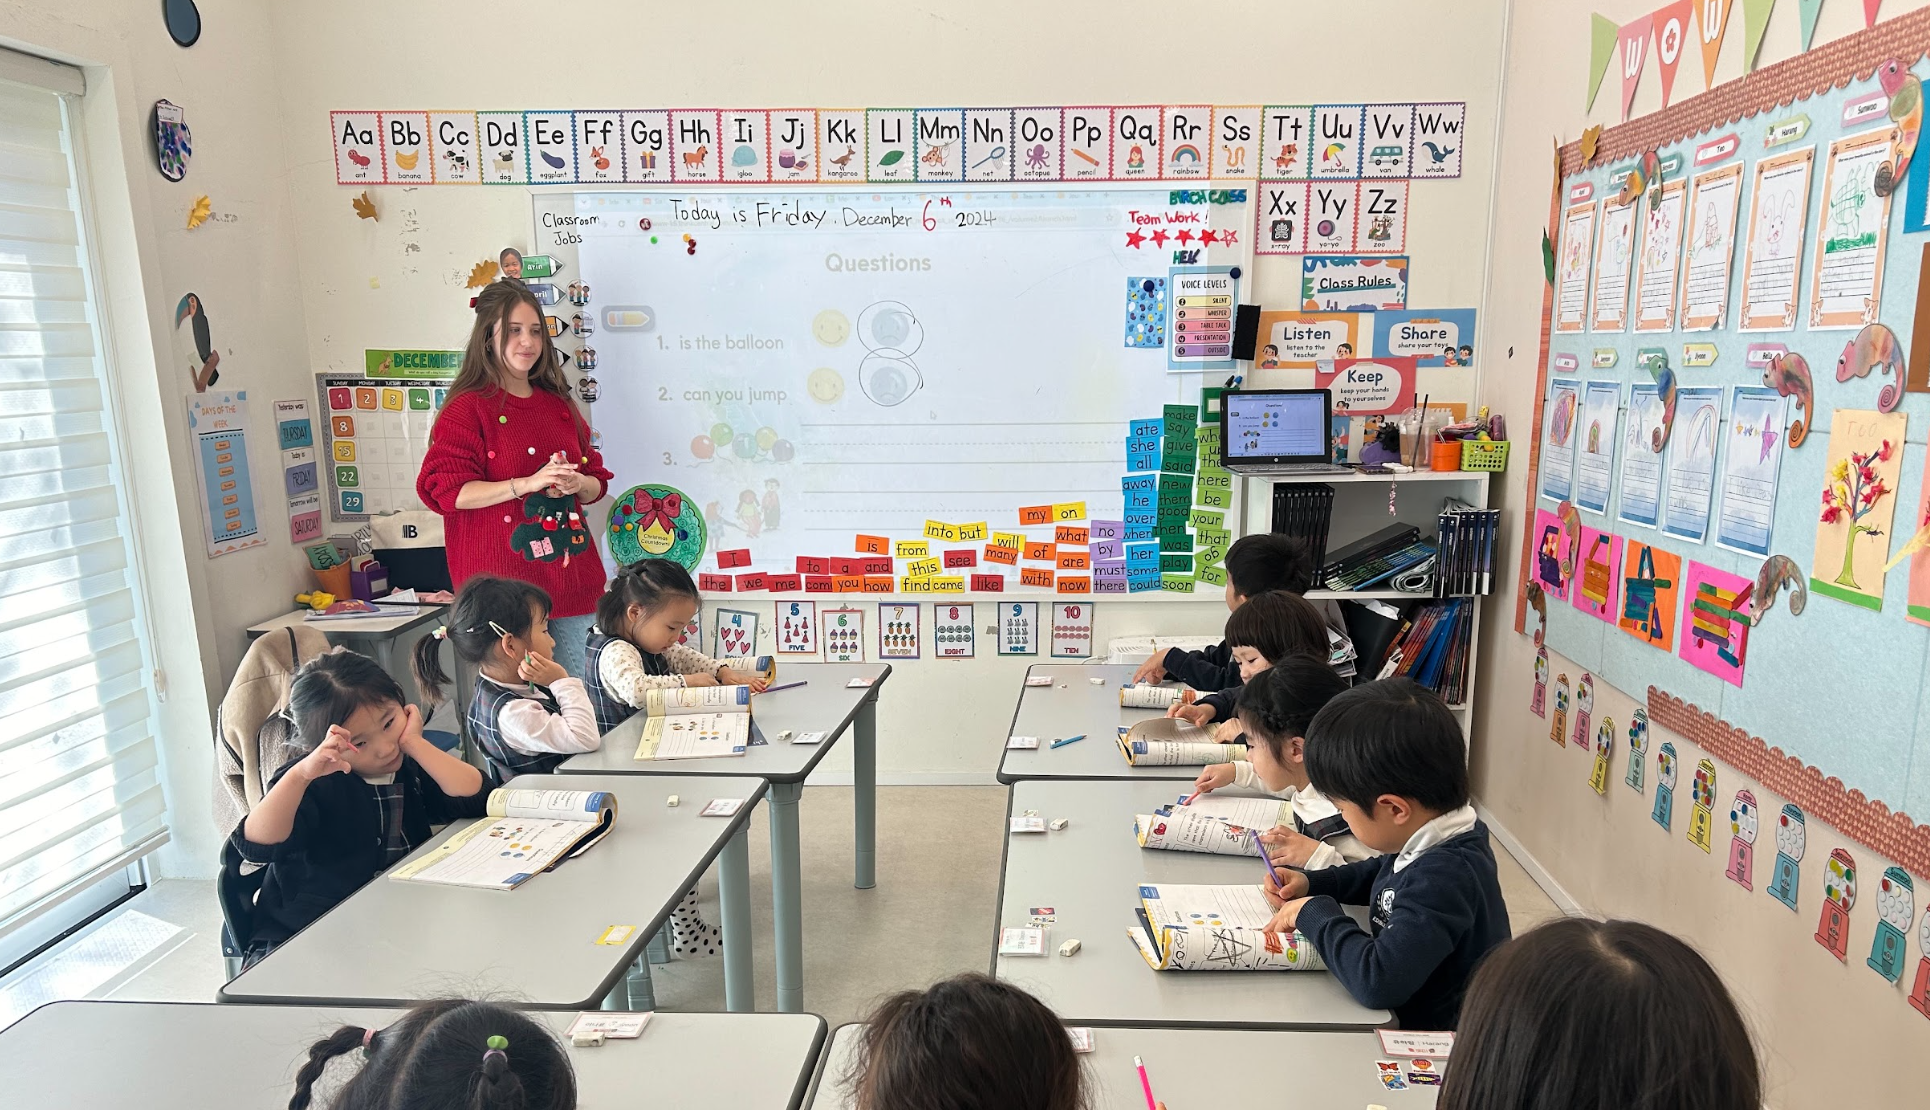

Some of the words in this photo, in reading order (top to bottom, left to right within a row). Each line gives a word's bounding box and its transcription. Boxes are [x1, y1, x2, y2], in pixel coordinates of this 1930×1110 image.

[733, 118, 753, 143] Ii
[828, 118, 857, 143] Kk
[881, 118, 901, 142] Ll
[920, 116, 960, 141] Mm
[973, 118, 1004, 143] Nn
[1021, 116, 1054, 142] Oo
[1120, 115, 1156, 146] Qq
[1173, 116, 1202, 141] Rr
[1222, 116, 1251, 142] Ss
[1273, 115, 1303, 140] Tt
[1322, 113, 1352, 139] Uu
[1373, 114, 1404, 139] Vv
[1419, 113, 1460, 135] Ww
[342, 121, 373, 146] Aa
[391, 121, 421, 146] Bb
[439, 120, 470, 146] Cc
[487, 122, 518, 147] Dd
[535, 120, 564, 145] Ee
[584, 120, 613, 145] Ff
[631, 120, 663, 151] Gg
[680, 119, 711, 144] Hh
[781, 118, 805, 150] Jj
[1073, 117, 1101, 148] Pp
[1269, 190, 1297, 216] Xx
[1318, 189, 1347, 220] Yy
[1367, 189, 1397, 215] Zz
[542, 212, 600, 229] Classroom
[670, 199, 721, 229] Today
[733, 205, 747, 228] is
[843, 206, 913, 227] December
[955, 209, 996, 228] 2024
[1129, 211, 1161, 225] Team
[1165, 211, 1200, 223] Work
[554, 231, 583, 246] Jobs
[825, 253, 932, 274] Questions
[1181, 280, 1201, 289] VOICE
[1204, 280, 1227, 288] LEVELS
[1319, 277, 1354, 290] Class
[1357, 276, 1392, 287] Rules
[1284, 327, 1331, 341] Listen
[1401, 326, 1447, 341] Share
[680, 335, 692, 350] is
[695, 334, 721, 350] the
[725, 334, 784, 350] balloon
[1417, 342, 1432, 350] your
[1347, 369, 1384, 386] Keep
[364, 394, 370, 404] 2
[683, 390, 711, 402] can
[715, 390, 743, 406] you
[746, 388, 787, 406] jump
[202, 407, 216, 416] DAYS
[225, 405, 236, 414] THE
[213, 420, 228, 428] WEEK
[340, 422, 348, 432] 8
[1135, 422, 1159, 436] ate
[1168, 422, 1190, 439] say
[1130, 438, 1155, 452] she
[1166, 440, 1193, 454] give
[1136, 455, 1152, 469] all
[1165, 459, 1193, 472] said
[293, 470, 311, 488] FRIDAY
[341, 472, 355, 483] 22
[1198, 472, 1229, 486] here
[1123, 479, 1155, 491] away
[346, 497, 360, 507] 29
[1133, 492, 1149, 506] he
[1205, 491, 1221, 505] be
[1027, 510, 1046, 523] my
[1061, 508, 1078, 519] on
[1126, 514, 1155, 524] over
[1158, 506, 1189, 520] good
[295, 518, 319, 535] SATURDAY
[1193, 514, 1221, 527] your
[927, 523, 953, 540] into
[959, 526, 981, 540] but
[1056, 527, 1087, 542] what
[1098, 526, 1115, 537] no
[1123, 528, 1152, 539] when
[1199, 530, 1228, 545] that
[867, 541, 878, 552] is
[997, 535, 1019, 548] will
[1164, 542, 1189, 551] was
[896, 544, 927, 556] from
[1033, 545, 1048, 558] of
[1098, 541, 1114, 557] by
[1131, 547, 1153, 560] her
[949, 555, 971, 566] see
[986, 548, 1017, 565] many
[1062, 557, 1084, 567] are
[1162, 556, 1188, 571] play
[807, 559, 820, 573] to
[865, 559, 890, 573] and
[911, 561, 938, 576] this
[1094, 564, 1125, 576] must
[1127, 567, 1158, 576] some
[1022, 572, 1050, 586] with
[1202, 566, 1221, 582] for
[704, 576, 726, 590] the
[743, 578, 762, 589] we
[775, 580, 796, 590] me
[837, 577, 859, 592] you
[864, 578, 891, 592] how
[903, 576, 931, 592] find
[933, 580, 963, 591] came
[977, 579, 999, 591] like
[1060, 580, 1086, 591] now
[1094, 580, 1125, 591] there
[1130, 576, 1161, 591] could
[1162, 581, 1193, 591] soon
[790, 603, 800, 616] 5
[893, 606, 904, 620] 7
[949, 607, 959, 620] 8
[1012, 604, 1023, 616] 9
[1064, 606, 1081, 619] 10
[731, 614, 742, 628] 4
[837, 613, 848, 627] 6
